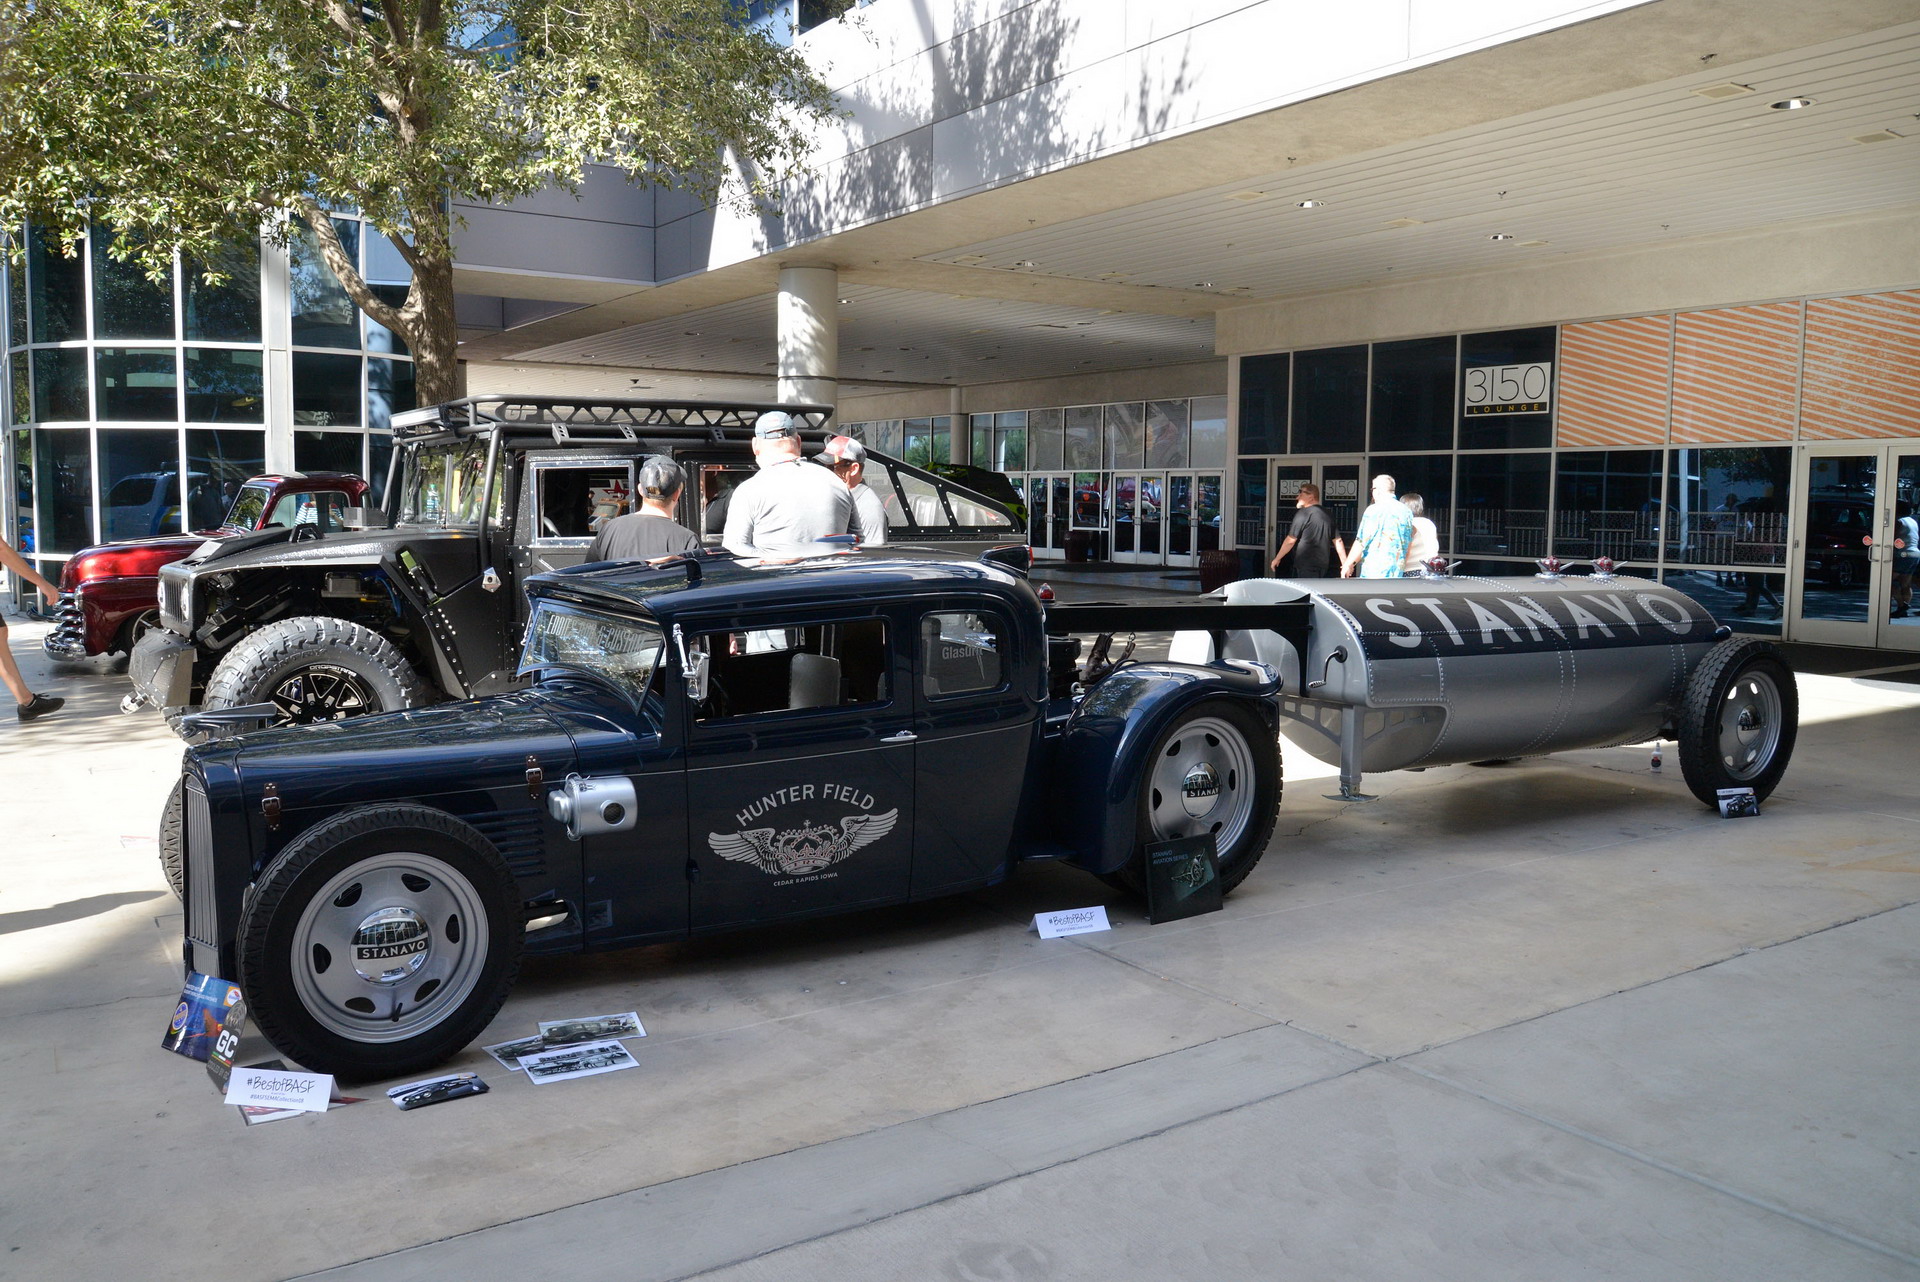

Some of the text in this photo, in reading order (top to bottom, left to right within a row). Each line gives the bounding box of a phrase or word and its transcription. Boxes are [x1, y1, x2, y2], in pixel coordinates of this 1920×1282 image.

[1467, 365, 1546, 403] 3150
[1473, 403, 1539, 413] LOUNGE
[1281, 480, 1309, 495] 315
[1326, 480, 1356, 495] 3150
[1365, 594, 1693, 648] STANAVO
[736, 783, 875, 826] HUNTER FIELD
[1153, 857, 1173, 865] AVIATION
[773, 872, 838, 887] CEDAR RAPIDS IOWA
[1049, 911, 1095, 926] #BestofBASF
[362, 941, 426, 959] STANAVO
[216, 1029, 238, 1059] GC
[247, 1076, 316, 1094] #BestofBASF
